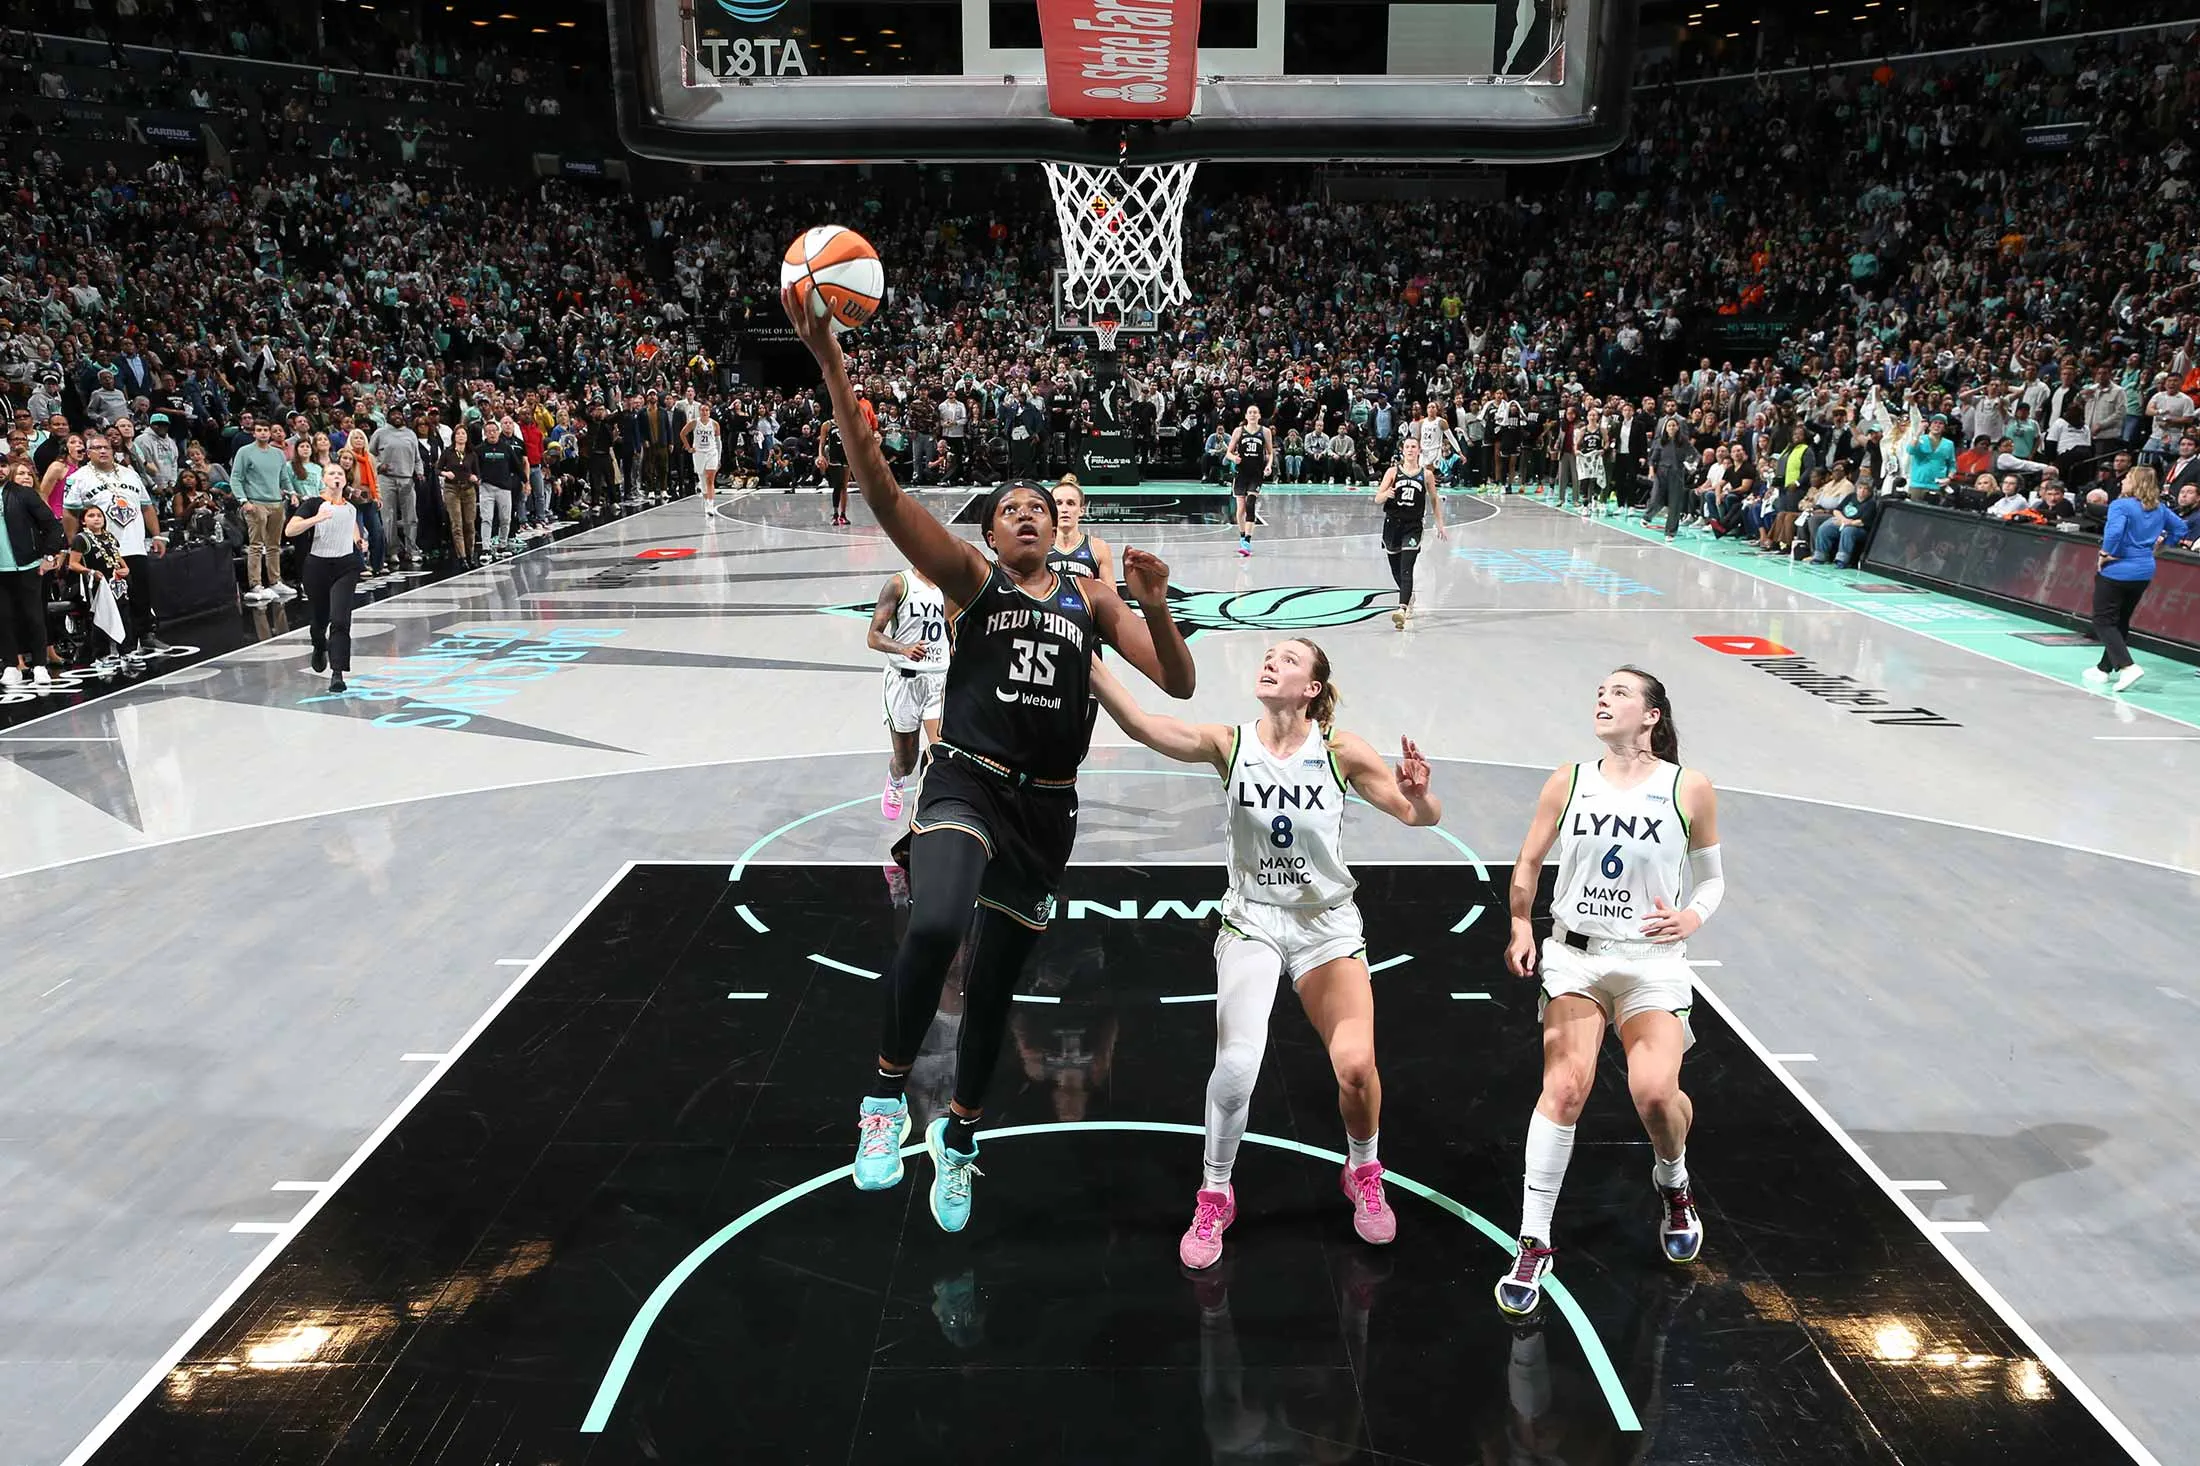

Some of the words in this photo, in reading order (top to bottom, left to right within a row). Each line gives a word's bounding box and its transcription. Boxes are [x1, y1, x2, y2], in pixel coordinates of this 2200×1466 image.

[1246, 442, 1257, 452] 30
[85, 484, 107, 500] NEW
[1401, 487, 1415, 500] 20
[910, 603, 944, 618] LYN
[921, 620, 941, 642] 10
[986, 609, 1030, 635] NEW
[1043, 612, 1083, 653] YORK
[1009, 638, 1059, 686] 35
[1022, 692, 1061, 709] Webull
[1239, 782, 1325, 809] LYNX
[1270, 815, 1293, 848] 8
[1573, 813, 1663, 844] LYNX
[1260, 857, 1306, 870] MAYO
[1601, 844, 1624, 879] 6
[1257, 872, 1312, 885] CLINIC
[1583, 886, 1631, 903] MAYO
[1576, 902, 1633, 920] CLINIC
